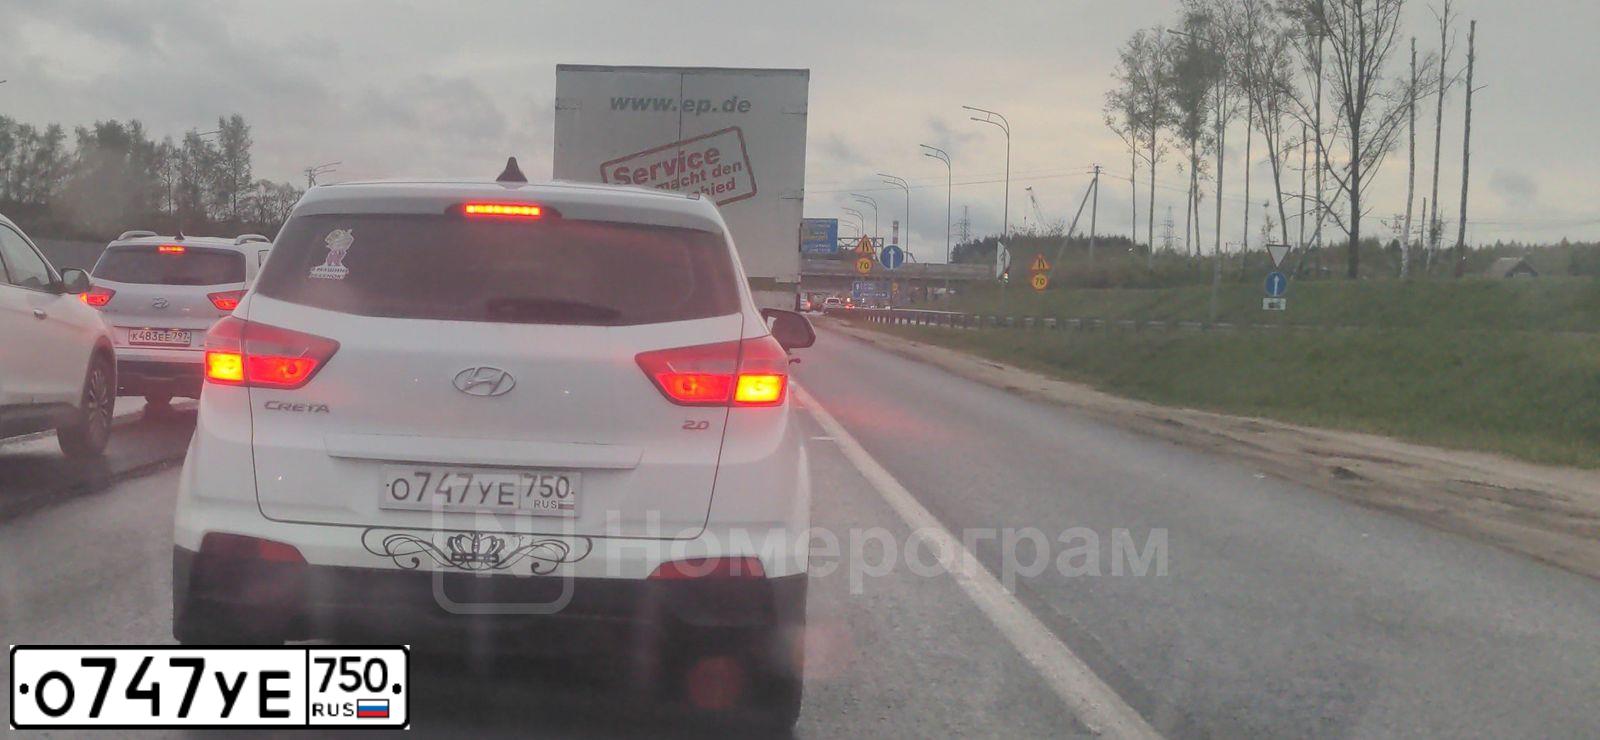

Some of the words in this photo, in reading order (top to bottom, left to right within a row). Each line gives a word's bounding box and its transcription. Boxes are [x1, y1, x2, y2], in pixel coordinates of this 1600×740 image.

[610, 96, 752, 116] www.ep.de
[613, 147, 720, 184] Service
[712, 161, 742, 177] den
[859, 261, 869, 269] 70
[1035, 277, 1045, 286] 70
[264, 400, 330, 413] CRETA
[391, 471, 514, 505] О747УЕ
[523, 473, 570, 499] 750
[534, 500, 557, 509] RUS
